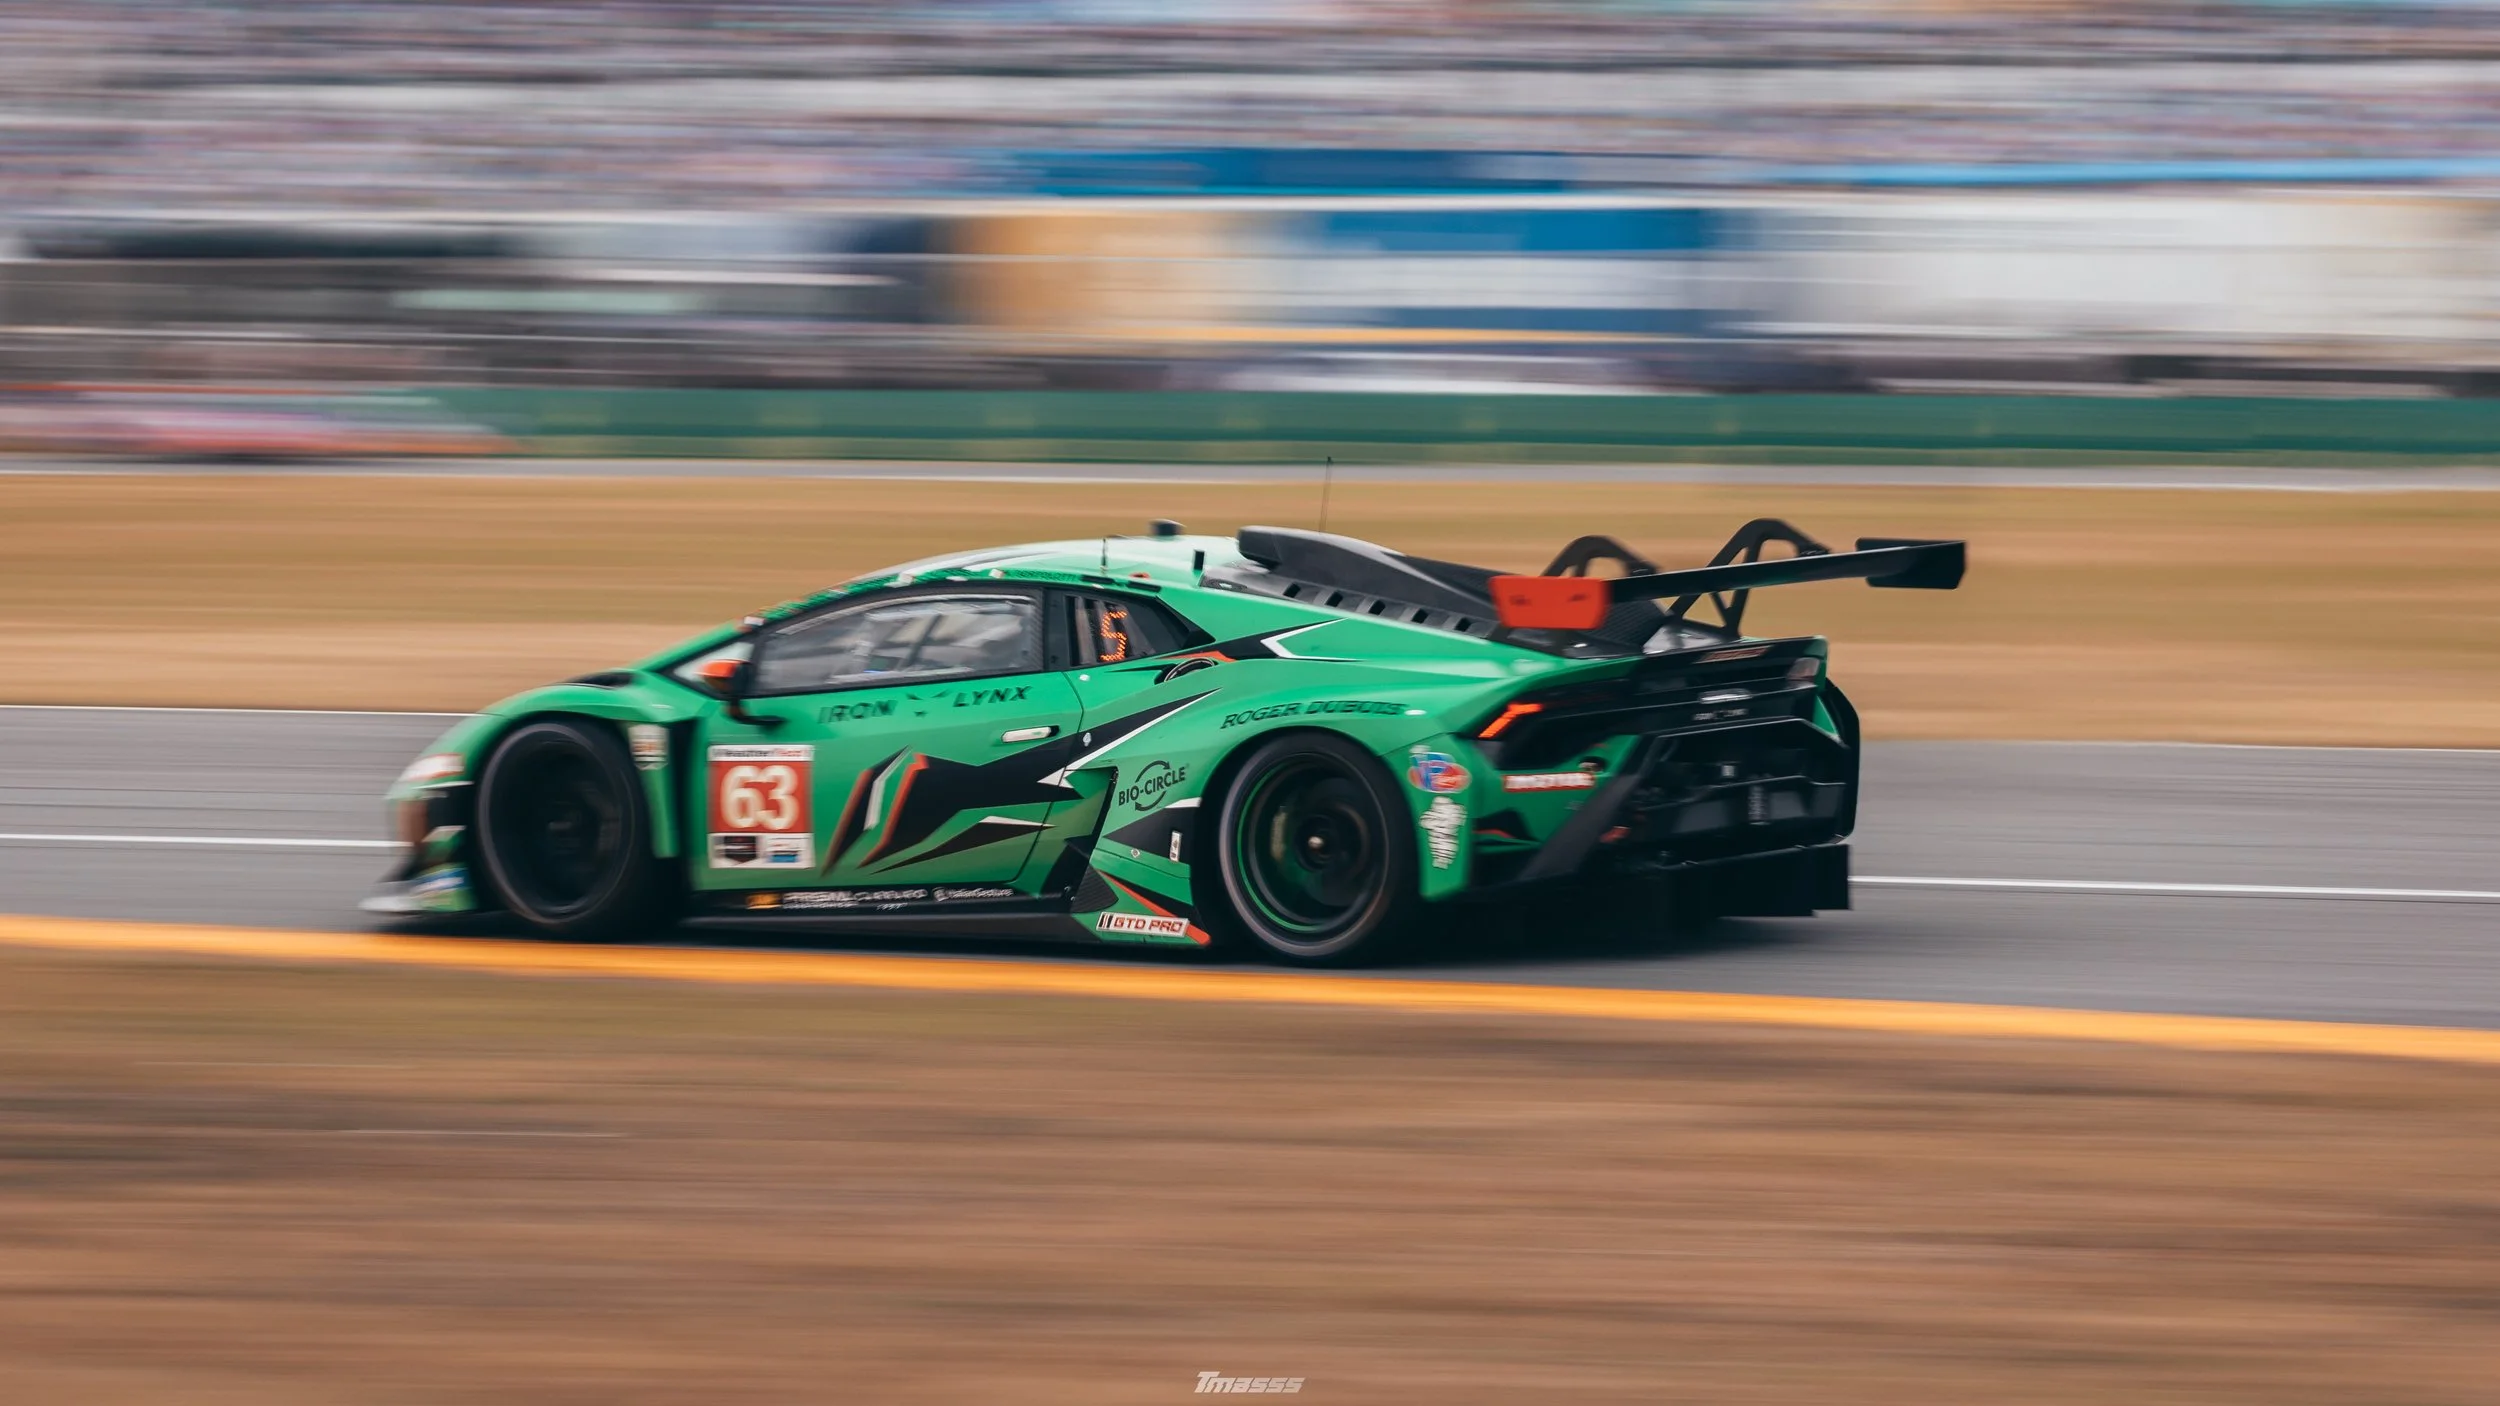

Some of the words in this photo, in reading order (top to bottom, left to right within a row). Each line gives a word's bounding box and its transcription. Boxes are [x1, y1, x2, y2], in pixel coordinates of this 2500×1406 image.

[1100, 610, 1127, 661] 5
[817, 700, 898, 724] IRON
[952, 686, 1032, 707] LYNX
[1220, 702, 1303, 729] ROGER
[1303, 700, 1409, 716] DUBUIS
[720, 765, 800, 830] 63
[1119, 766, 1186, 806] BIO-CIRCLE
[1114, 917, 1146, 929] GTD
[1148, 919, 1183, 933] PRO
